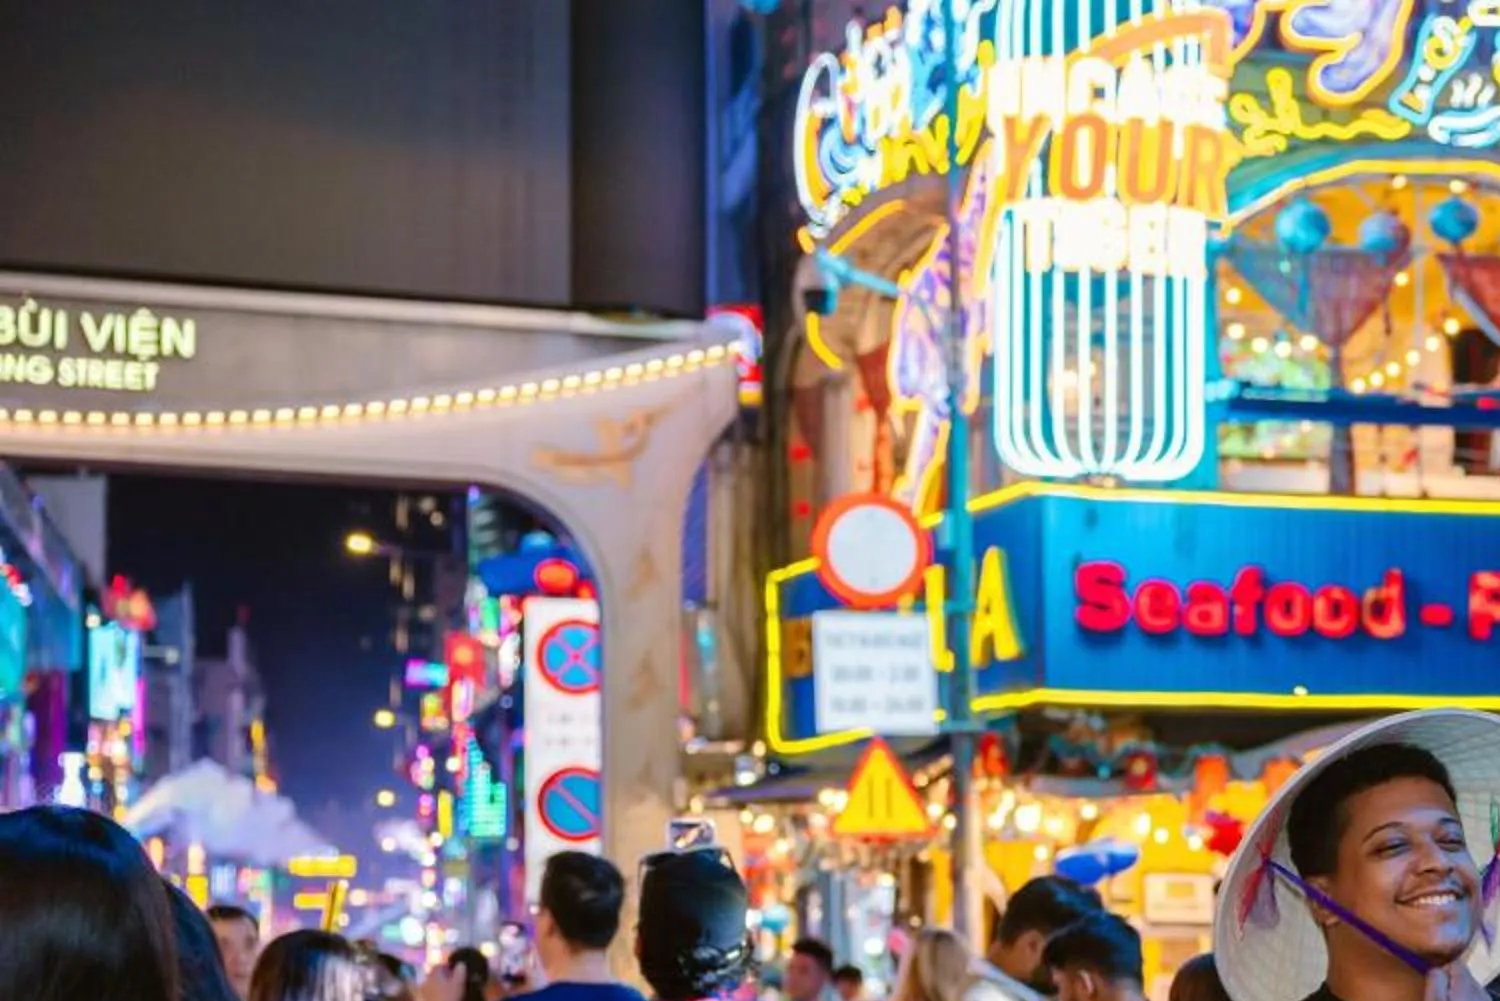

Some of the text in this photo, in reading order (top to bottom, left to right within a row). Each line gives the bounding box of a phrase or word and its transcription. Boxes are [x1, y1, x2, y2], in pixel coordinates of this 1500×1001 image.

[1002, 112, 1226, 215] YOUR
[80, 307, 196, 361] VIỆN
[58, 356, 160, 391] STREET
[1074, 560, 1406, 640] Seafood
